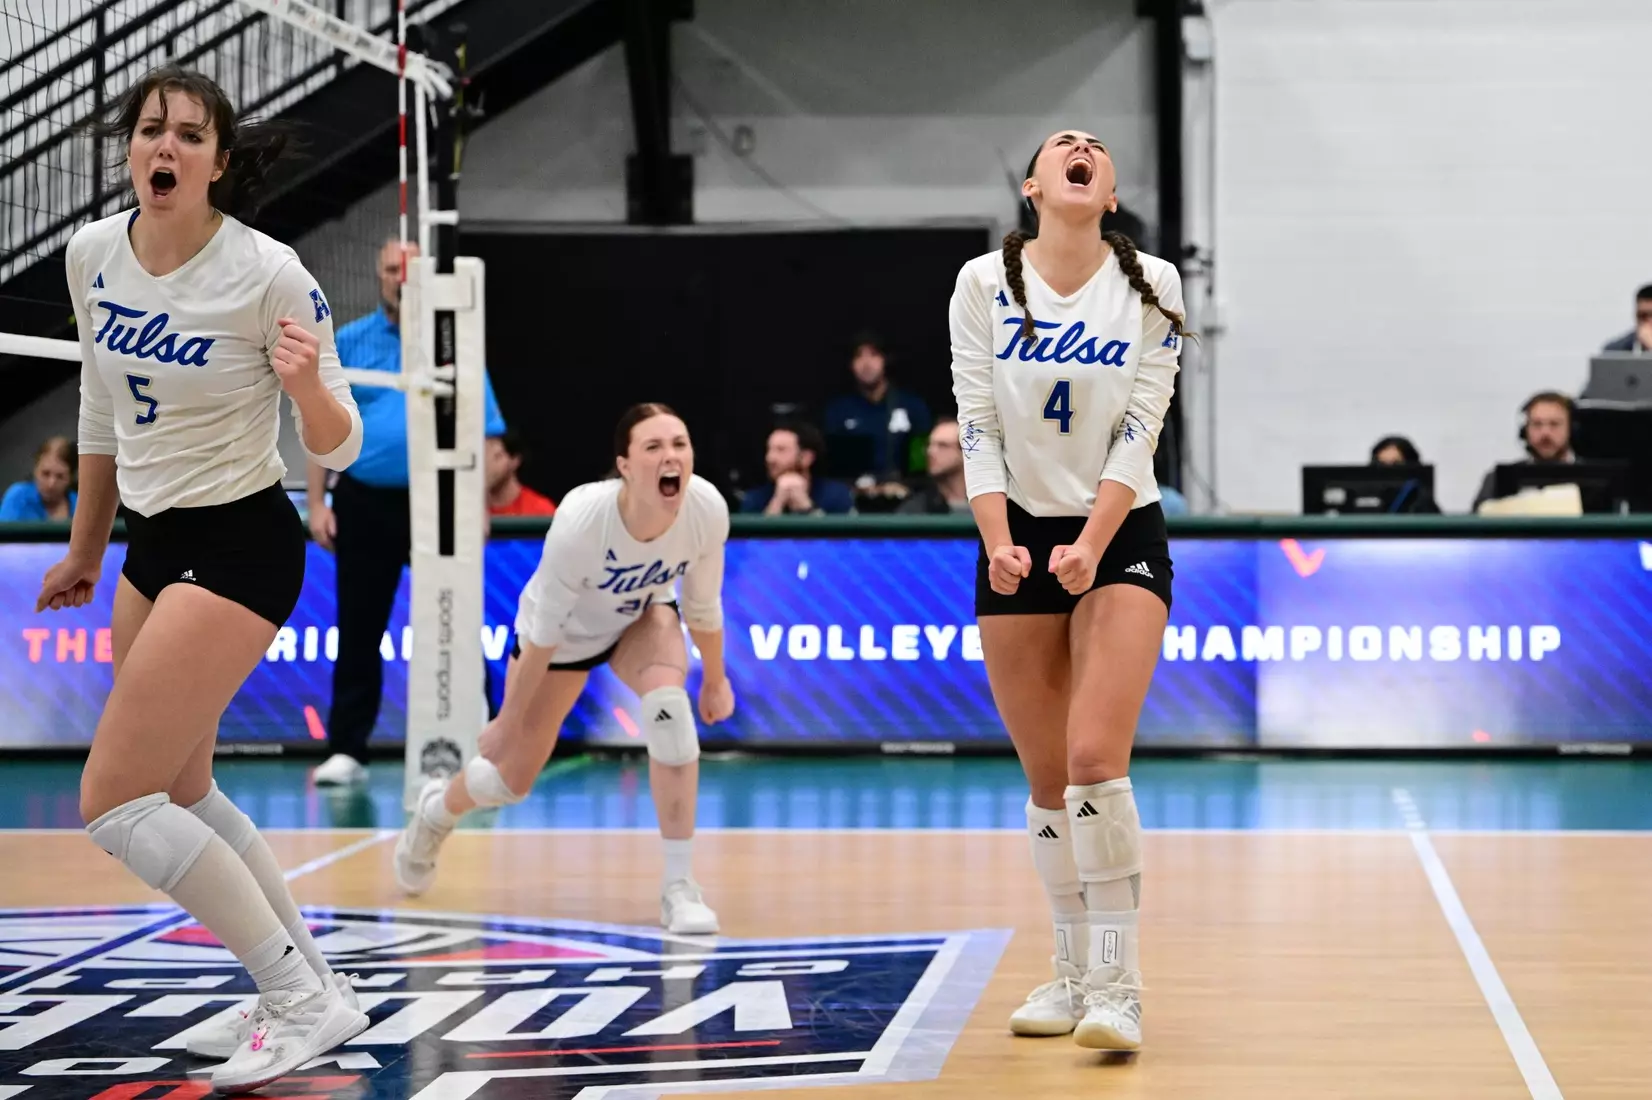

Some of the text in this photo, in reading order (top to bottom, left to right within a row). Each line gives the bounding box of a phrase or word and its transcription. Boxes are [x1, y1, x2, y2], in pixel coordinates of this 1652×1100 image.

[95, 301, 215, 366] Tulsa
[996, 317, 1131, 367] Tulsa
[126, 373, 158, 425] 5
[1043, 379, 1074, 434] 4
[598, 559, 690, 594] Tulsa
[22, 628, 113, 663] THE
[749, 624, 1561, 662] VOLLEYB HAMPIONSHIP
